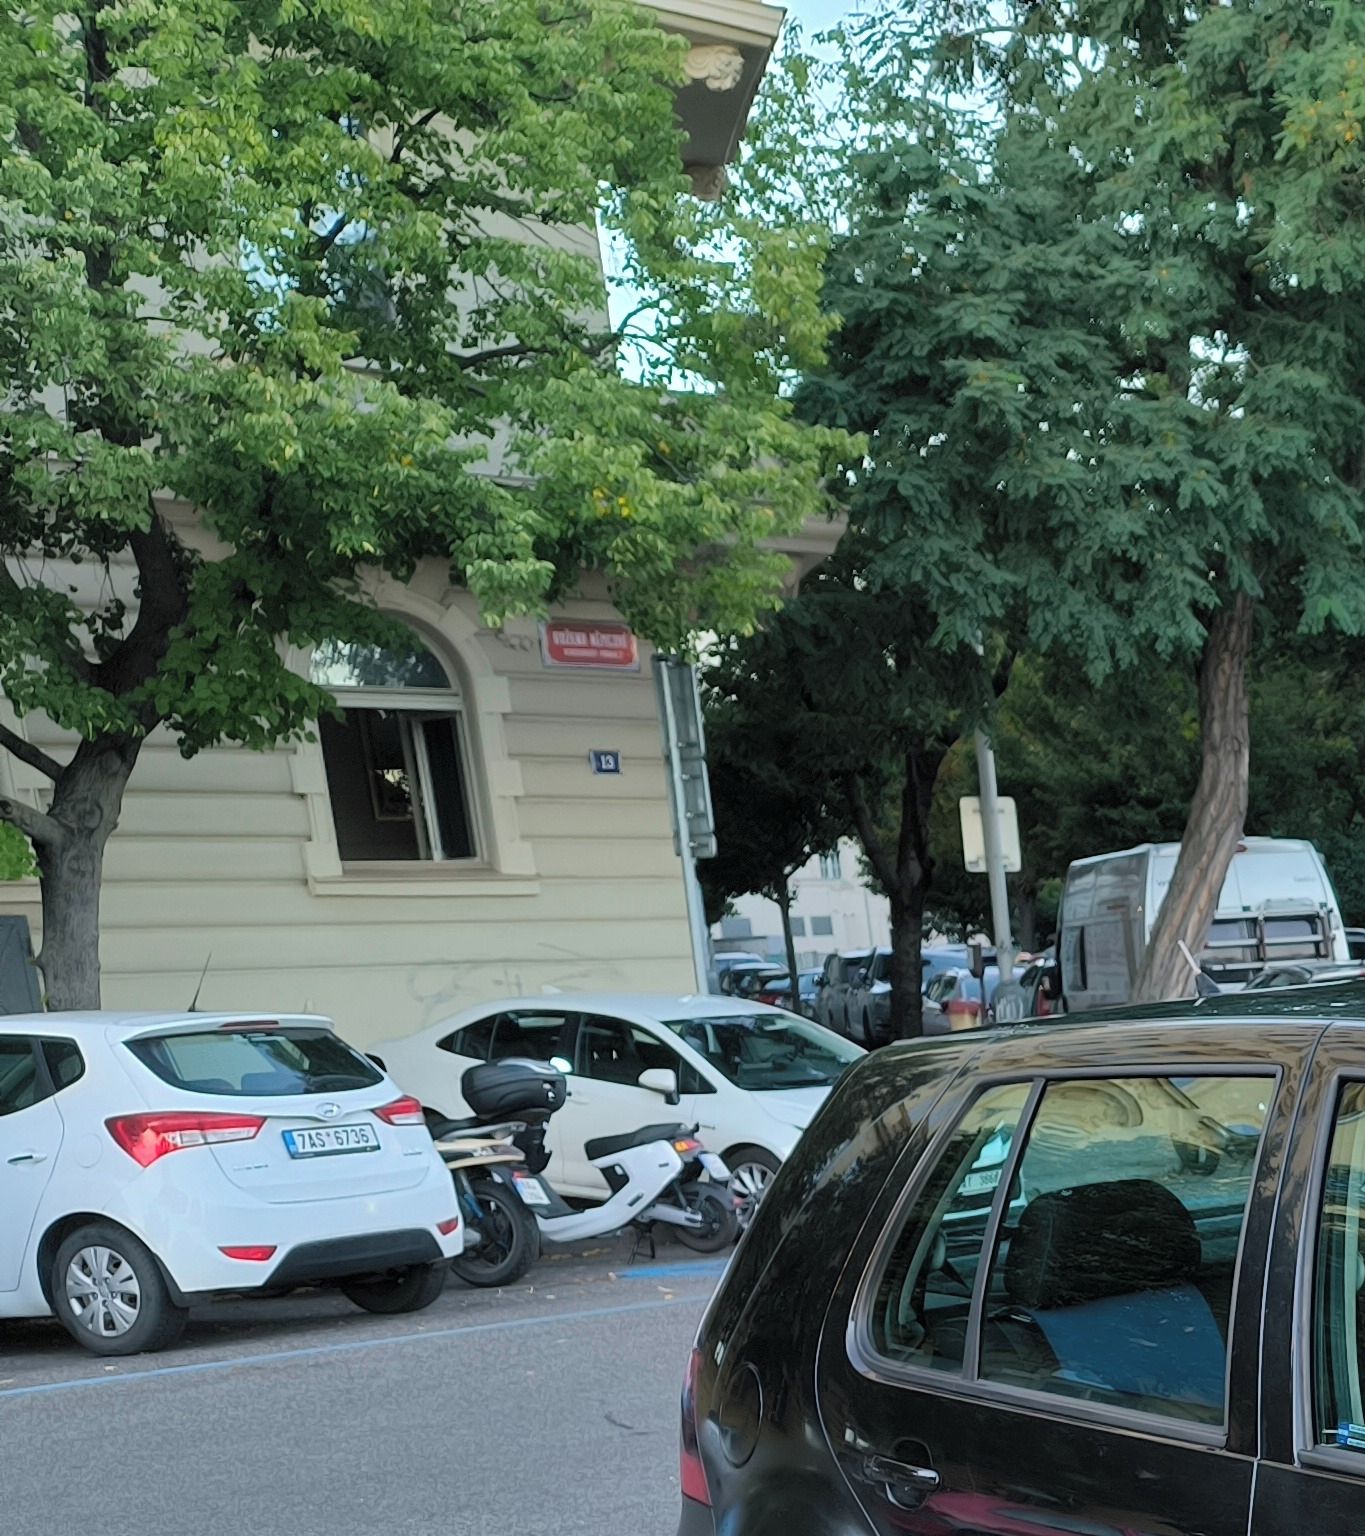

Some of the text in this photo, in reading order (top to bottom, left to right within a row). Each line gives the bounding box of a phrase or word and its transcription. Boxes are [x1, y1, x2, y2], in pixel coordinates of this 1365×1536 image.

[599, 754, 615, 770] 13
[296, 1127, 370, 1150] 7AS 6736
